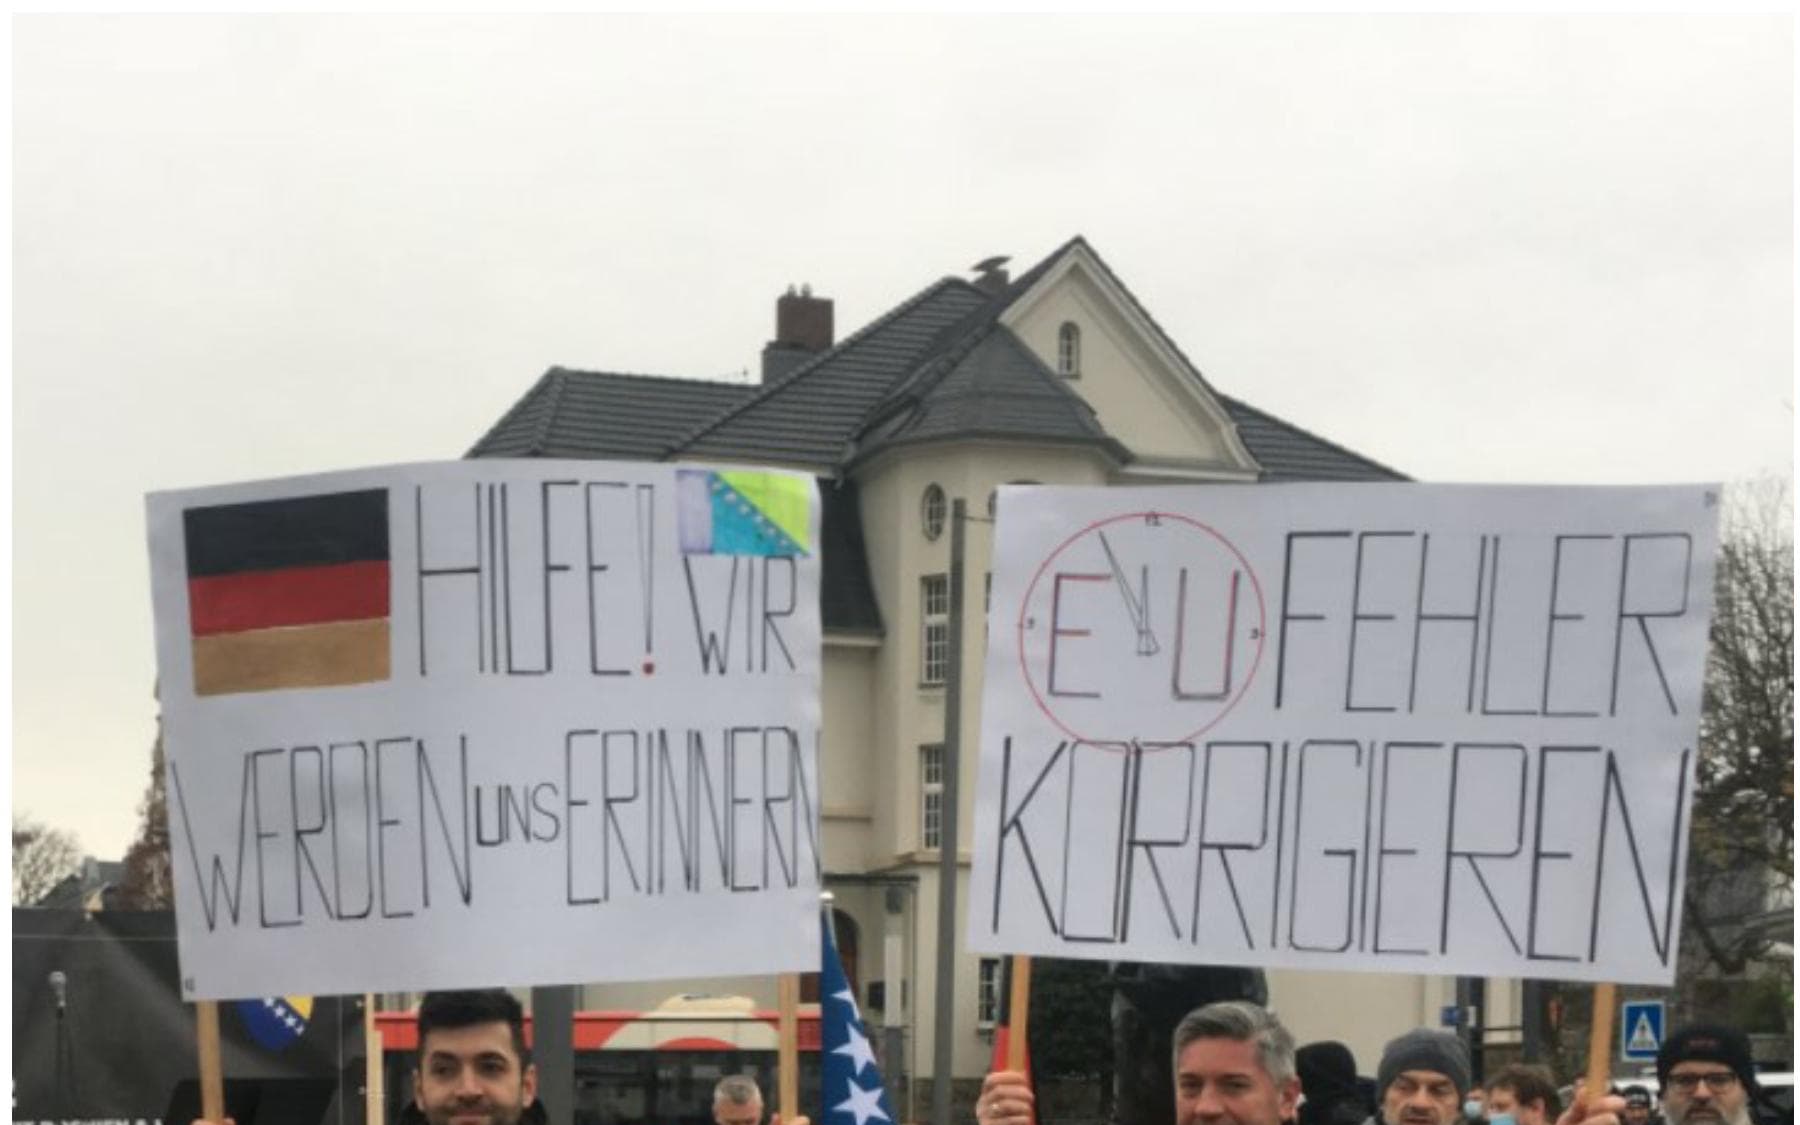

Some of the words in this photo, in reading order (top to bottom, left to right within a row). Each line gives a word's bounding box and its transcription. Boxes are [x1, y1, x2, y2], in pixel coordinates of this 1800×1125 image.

[415, 480, 655, 677] HILFE!
[682, 554, 797, 675] WIR
[1275, 530, 1692, 718] FEHLER
[170, 733, 473, 933] WERDEN
[566, 726, 822, 905] ERINNERN
[992, 735, 1690, 968] KORRIGIEREN
